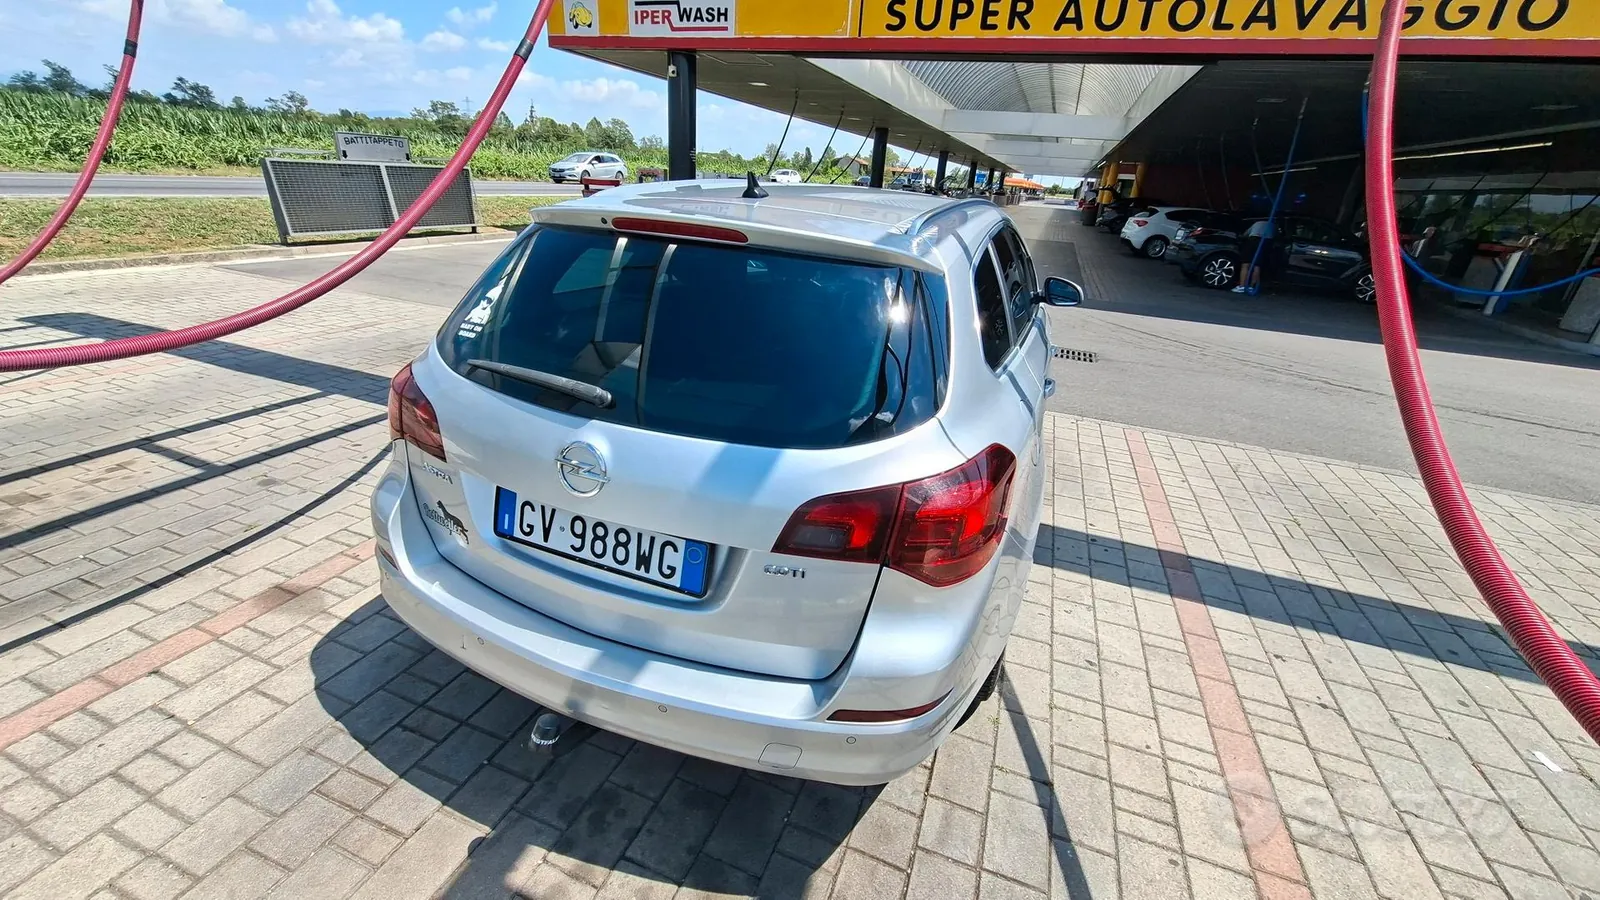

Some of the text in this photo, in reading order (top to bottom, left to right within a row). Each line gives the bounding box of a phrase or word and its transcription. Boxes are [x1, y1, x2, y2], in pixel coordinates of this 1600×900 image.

[634, 7, 729, 25] IPER WASH
[885, 0, 1035, 31] SUPER
[344, 136, 404, 148] BATTITAPPETO
